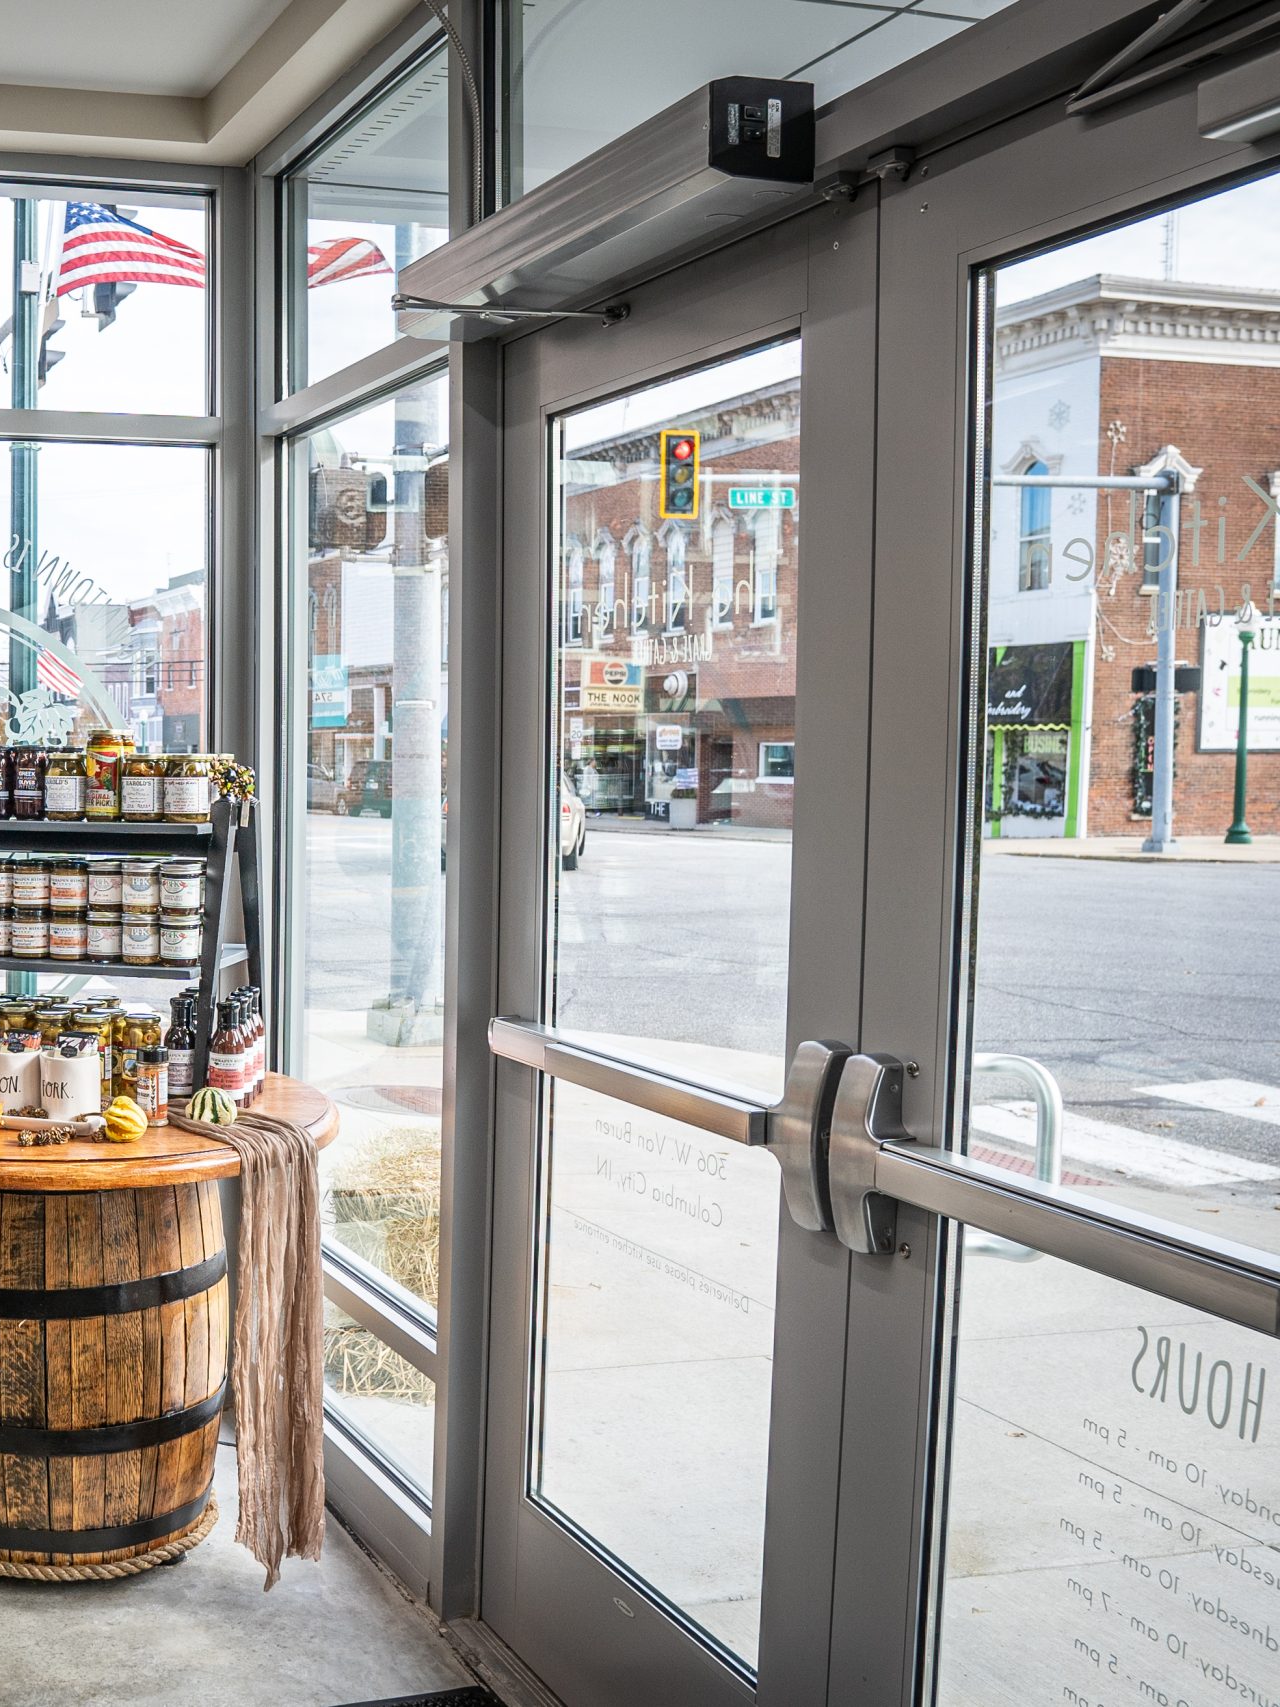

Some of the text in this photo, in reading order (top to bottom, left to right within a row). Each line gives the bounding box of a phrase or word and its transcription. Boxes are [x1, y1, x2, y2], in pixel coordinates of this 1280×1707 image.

[735, 490, 788, 505] LINE ST
[605, 670, 626, 678] PEPSI
[588, 692, 640, 703] THE NOOK
[1005, 684, 1027, 699] and
[1023, 734, 1067, 754] BUSINE
[650, 801, 667, 816] THE
[42, 1080, 74, 1099] FORK.
